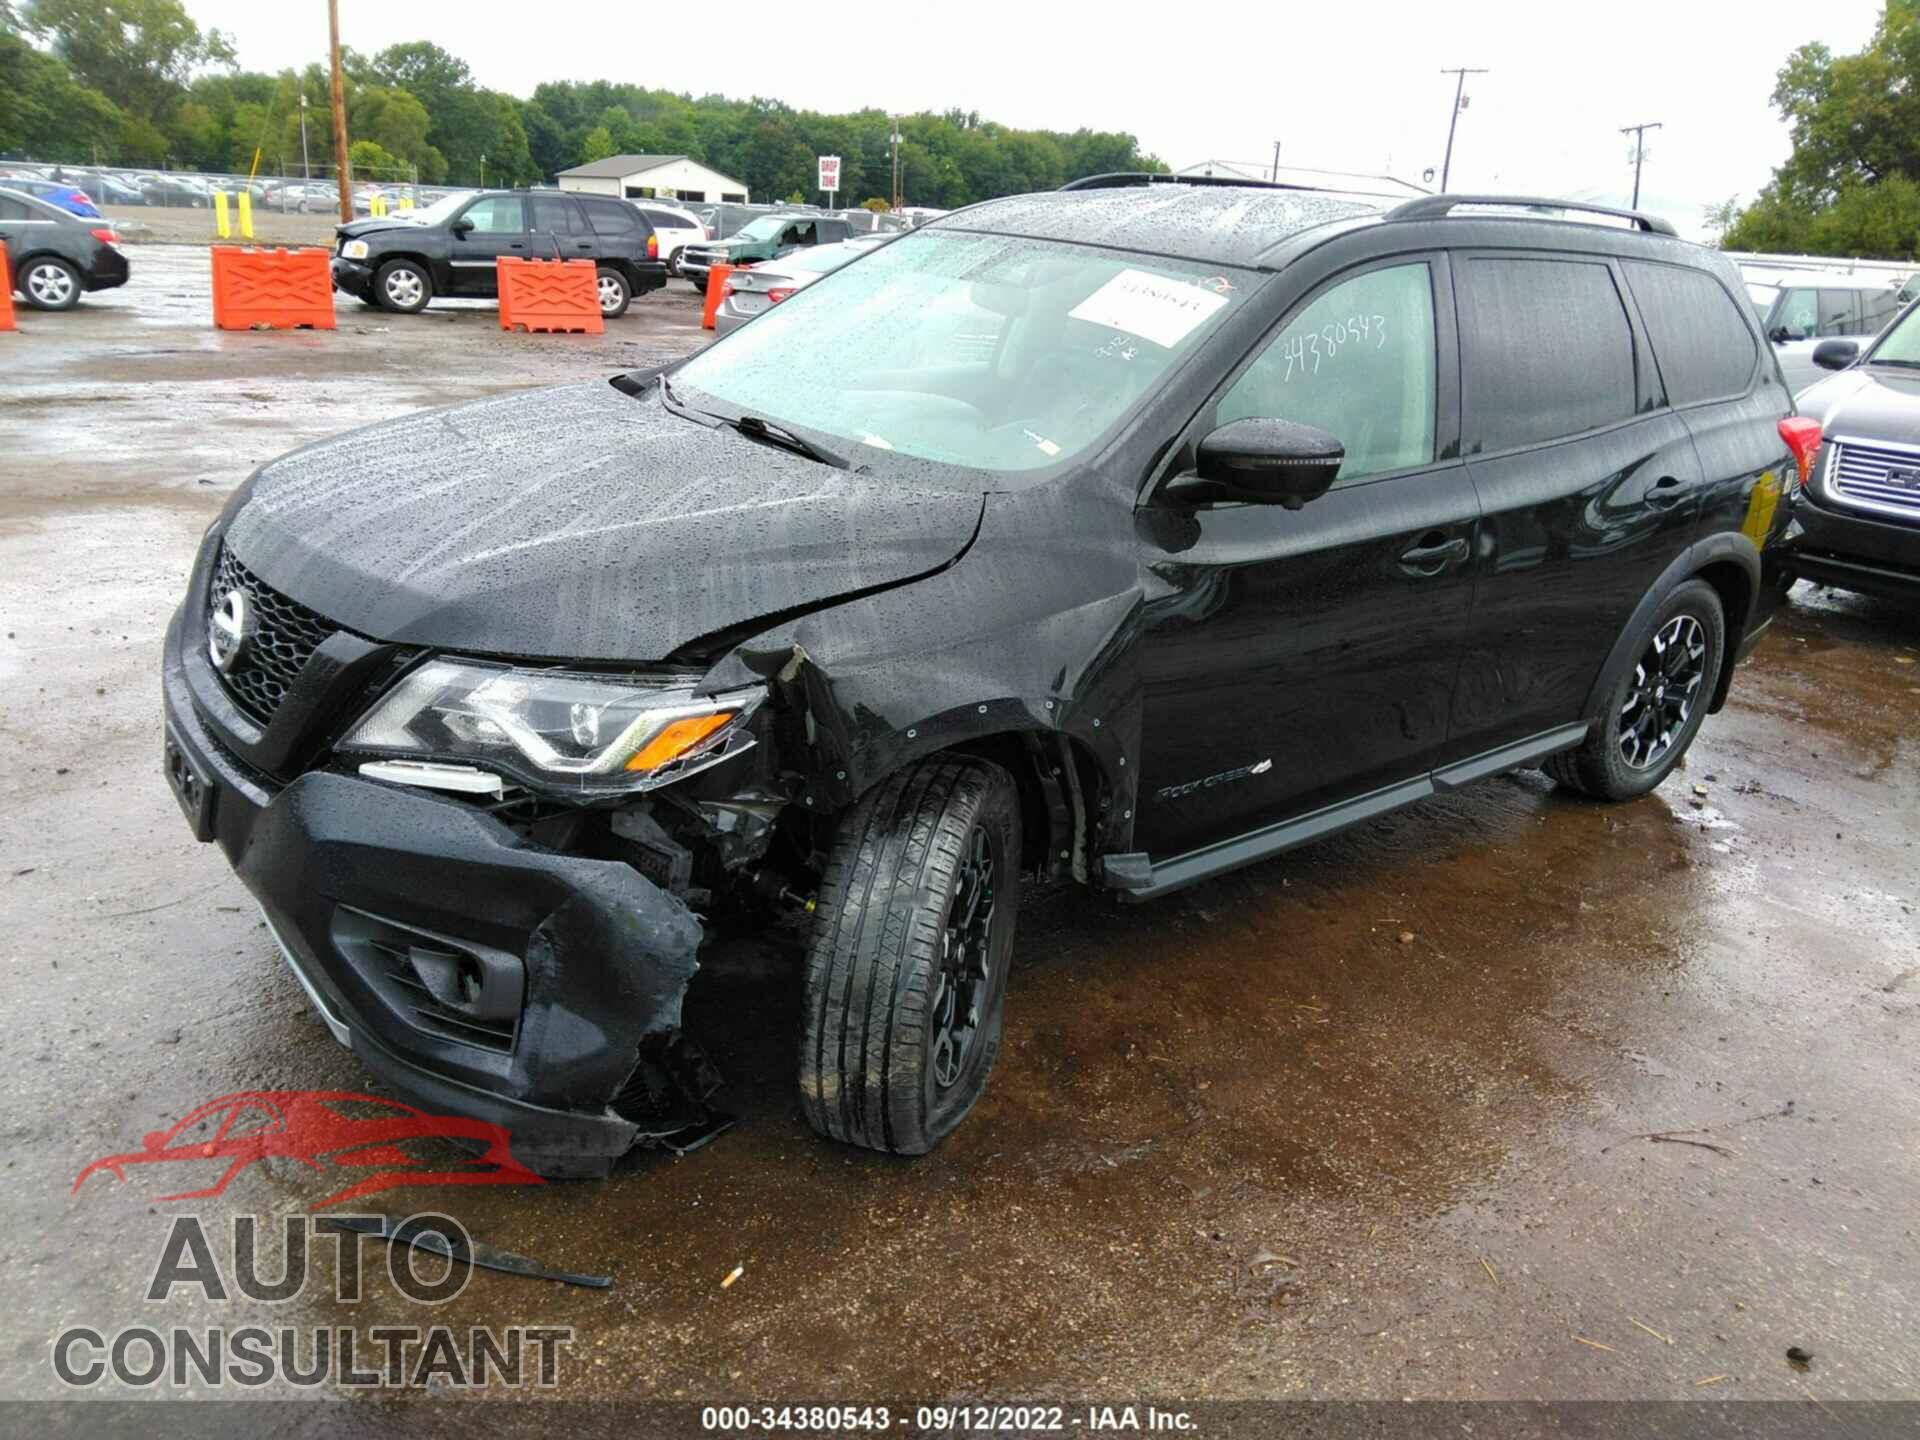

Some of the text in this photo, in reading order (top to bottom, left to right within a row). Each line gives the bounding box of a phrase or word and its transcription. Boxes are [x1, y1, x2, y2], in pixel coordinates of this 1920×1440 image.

[821, 160, 837, 172] DROP
[822, 175, 836, 187] ZONE
[1283, 314, 1385, 382] 34380543
